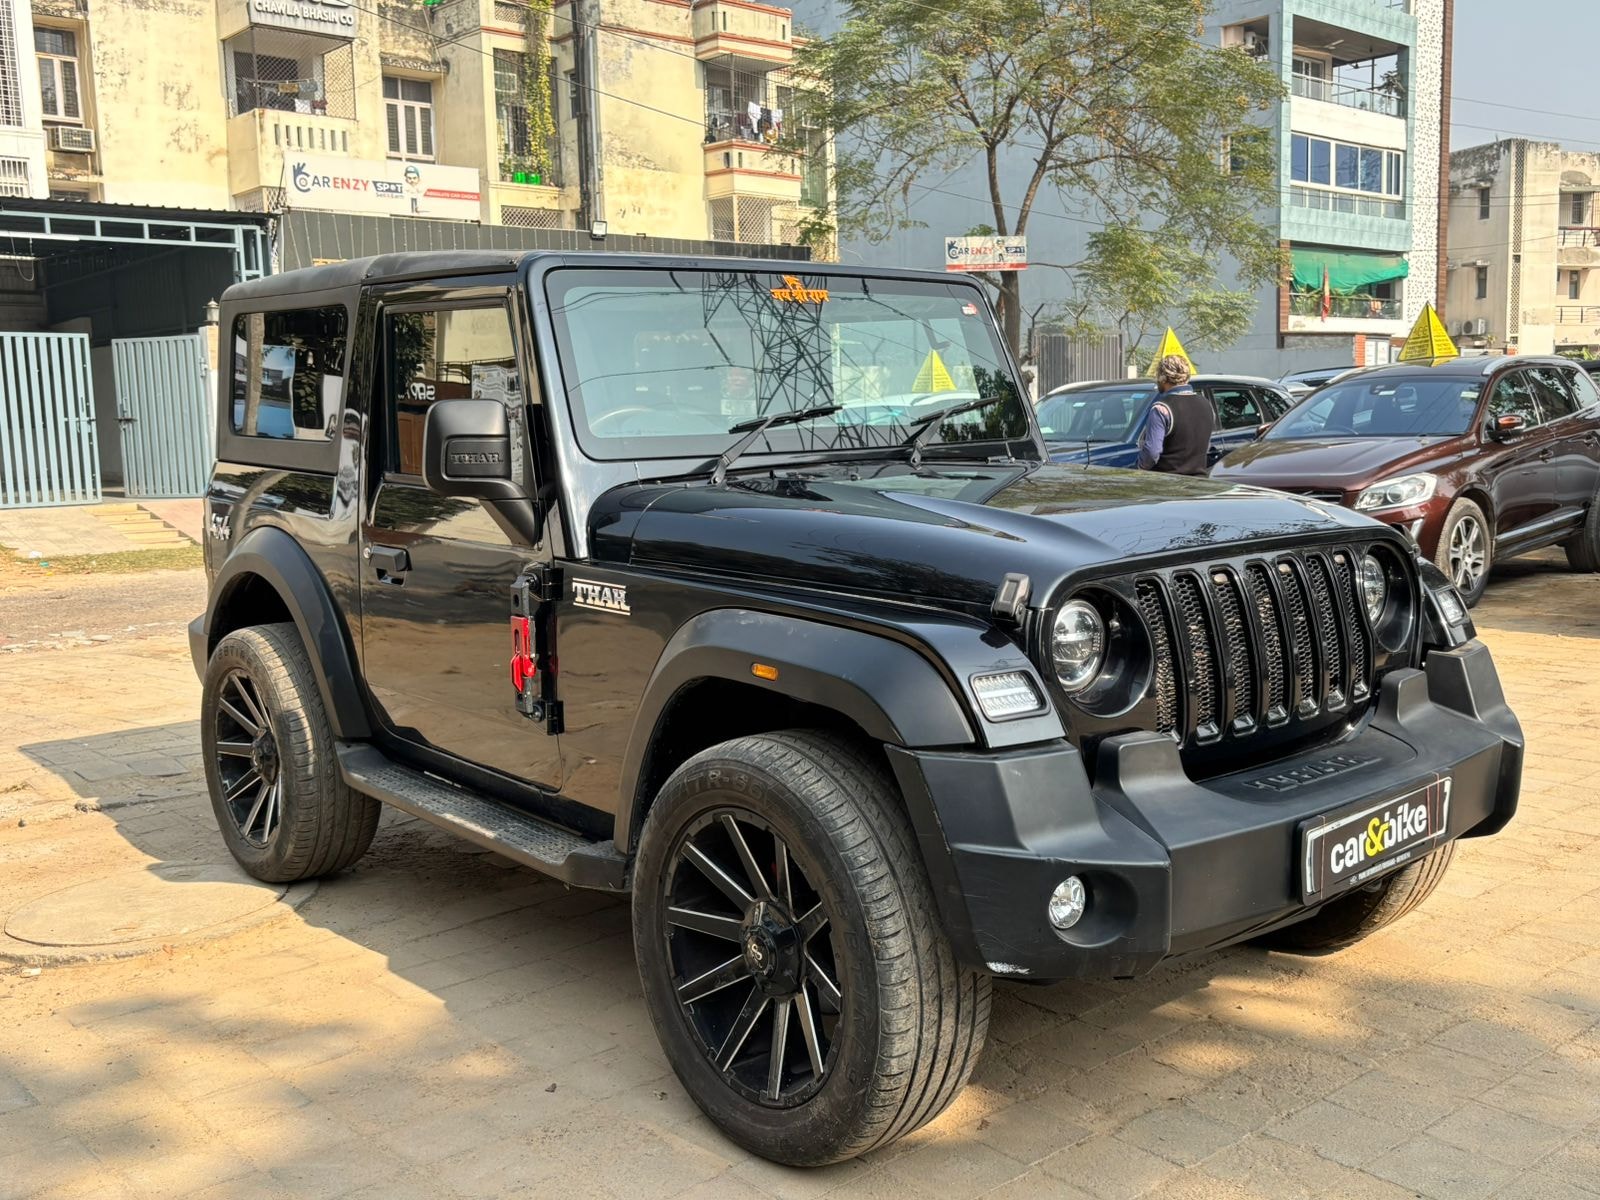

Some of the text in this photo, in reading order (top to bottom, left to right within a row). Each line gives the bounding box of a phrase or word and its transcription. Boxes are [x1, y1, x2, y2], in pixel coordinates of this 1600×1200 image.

[255, 1, 300, 17] CHAWLA
[303, 7, 338, 24] BHASIN
[340, 14, 354, 26] CO
[451, 452, 503, 465] THAR
[572, 581, 631, 612] THAR
[1330, 802, 1428, 875] car&bike
